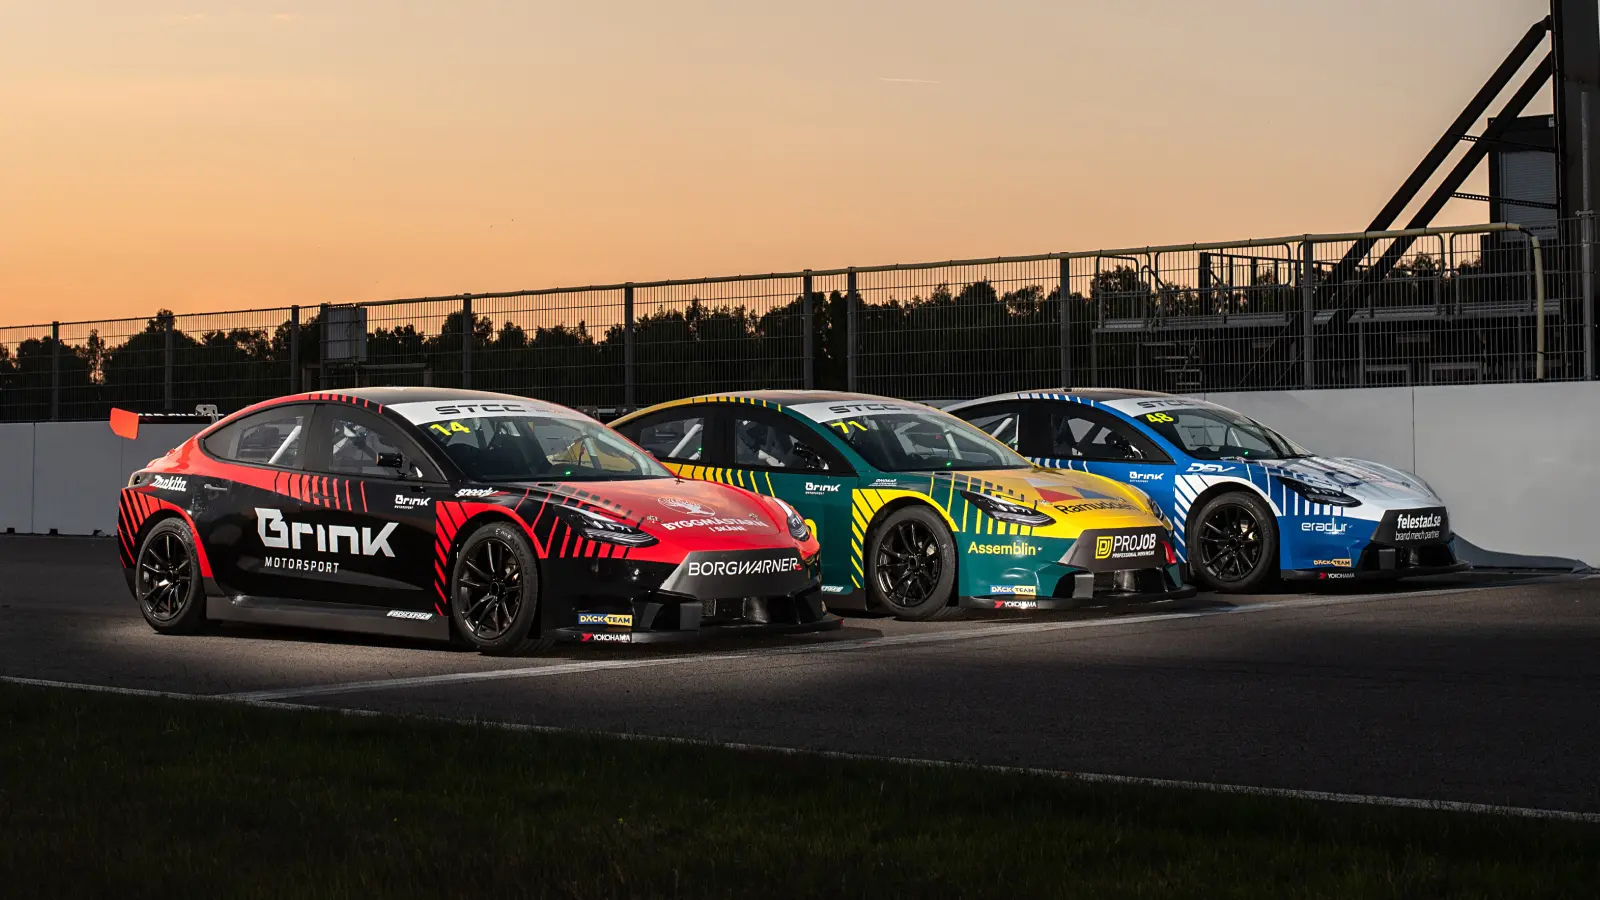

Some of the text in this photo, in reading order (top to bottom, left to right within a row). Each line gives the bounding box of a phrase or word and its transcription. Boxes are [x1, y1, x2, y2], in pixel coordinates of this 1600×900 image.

[435, 404, 526, 415] STCC
[828, 403, 902, 414] STCC
[1145, 412, 1174, 423] 48
[430, 421, 471, 437] 14
[831, 420, 868, 434] 71
[1186, 462, 1236, 472] DSV
[1301, 516, 1347, 532] eradur
[1398, 513, 1441, 529] felestad.se
[967, 541, 1037, 556] Assemblin
[1113, 534, 1157, 551] PROJOB
[264, 556, 340, 574] MOTORSPORT
[688, 557, 798, 576] BORGWARNER
[580, 614, 631, 624] DÄCK TEAM
[592, 633, 631, 642] YOKOHAMA
